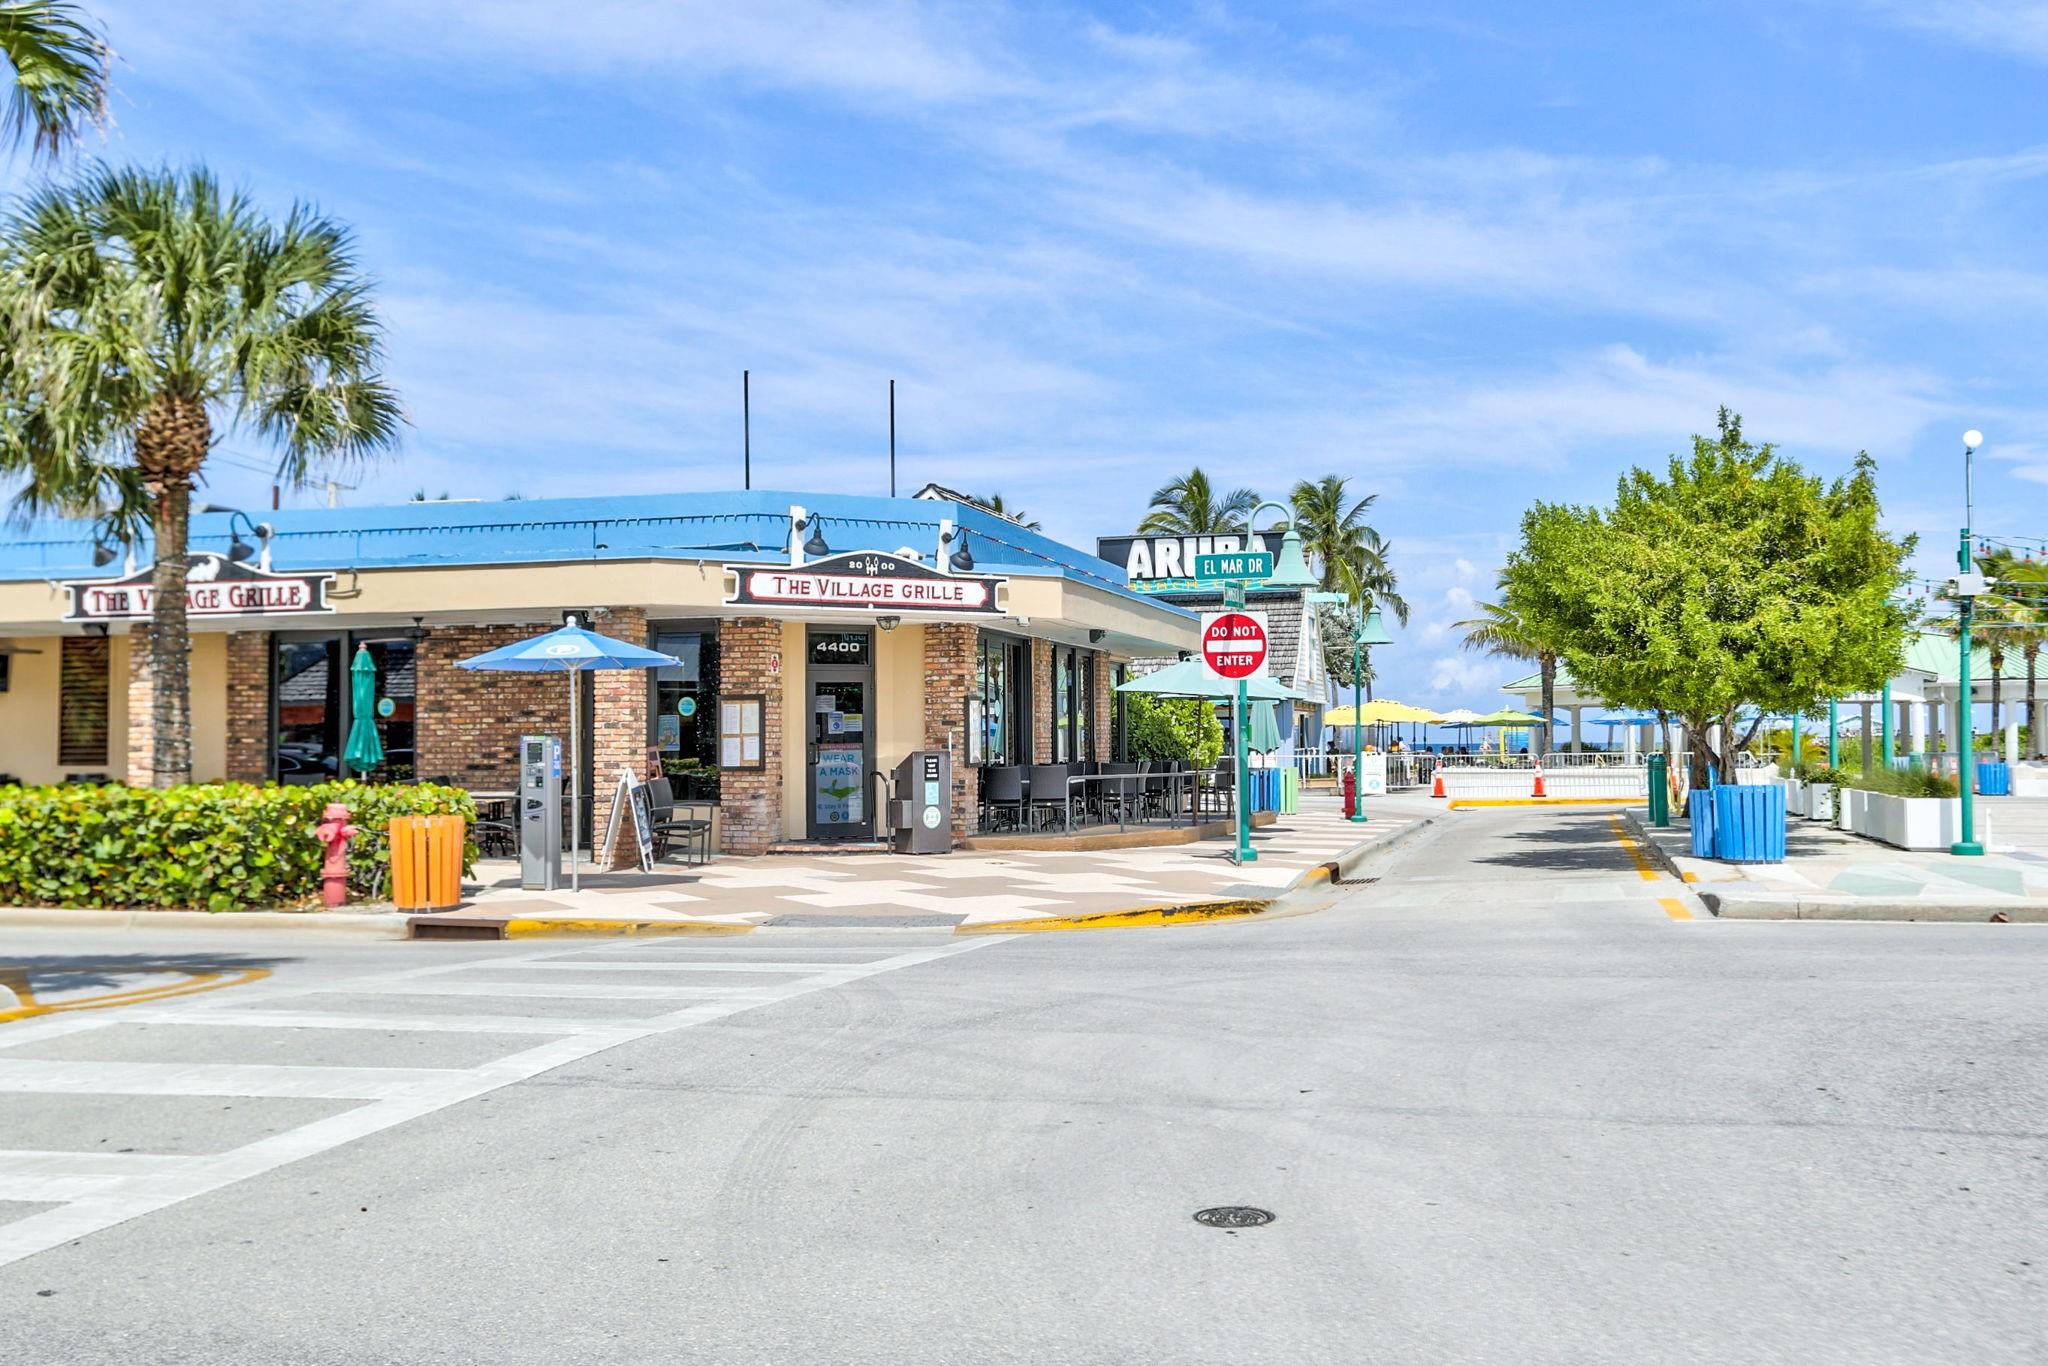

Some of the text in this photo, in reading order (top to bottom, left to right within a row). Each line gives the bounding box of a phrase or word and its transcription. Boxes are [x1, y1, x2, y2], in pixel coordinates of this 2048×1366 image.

[1204, 558, 1263, 575] EL MAR DR
[773, 577, 964, 600] THE VILLAGE GRILLE
[93, 585, 301, 611] THE VAGE GRILLE
[1211, 626, 1257, 637] DO NOT
[816, 642, 860, 652] 4400
[1216, 655, 1253, 667] ENTER
[823, 754, 855, 763] WEAR
[820, 767, 858, 776] A MASK
